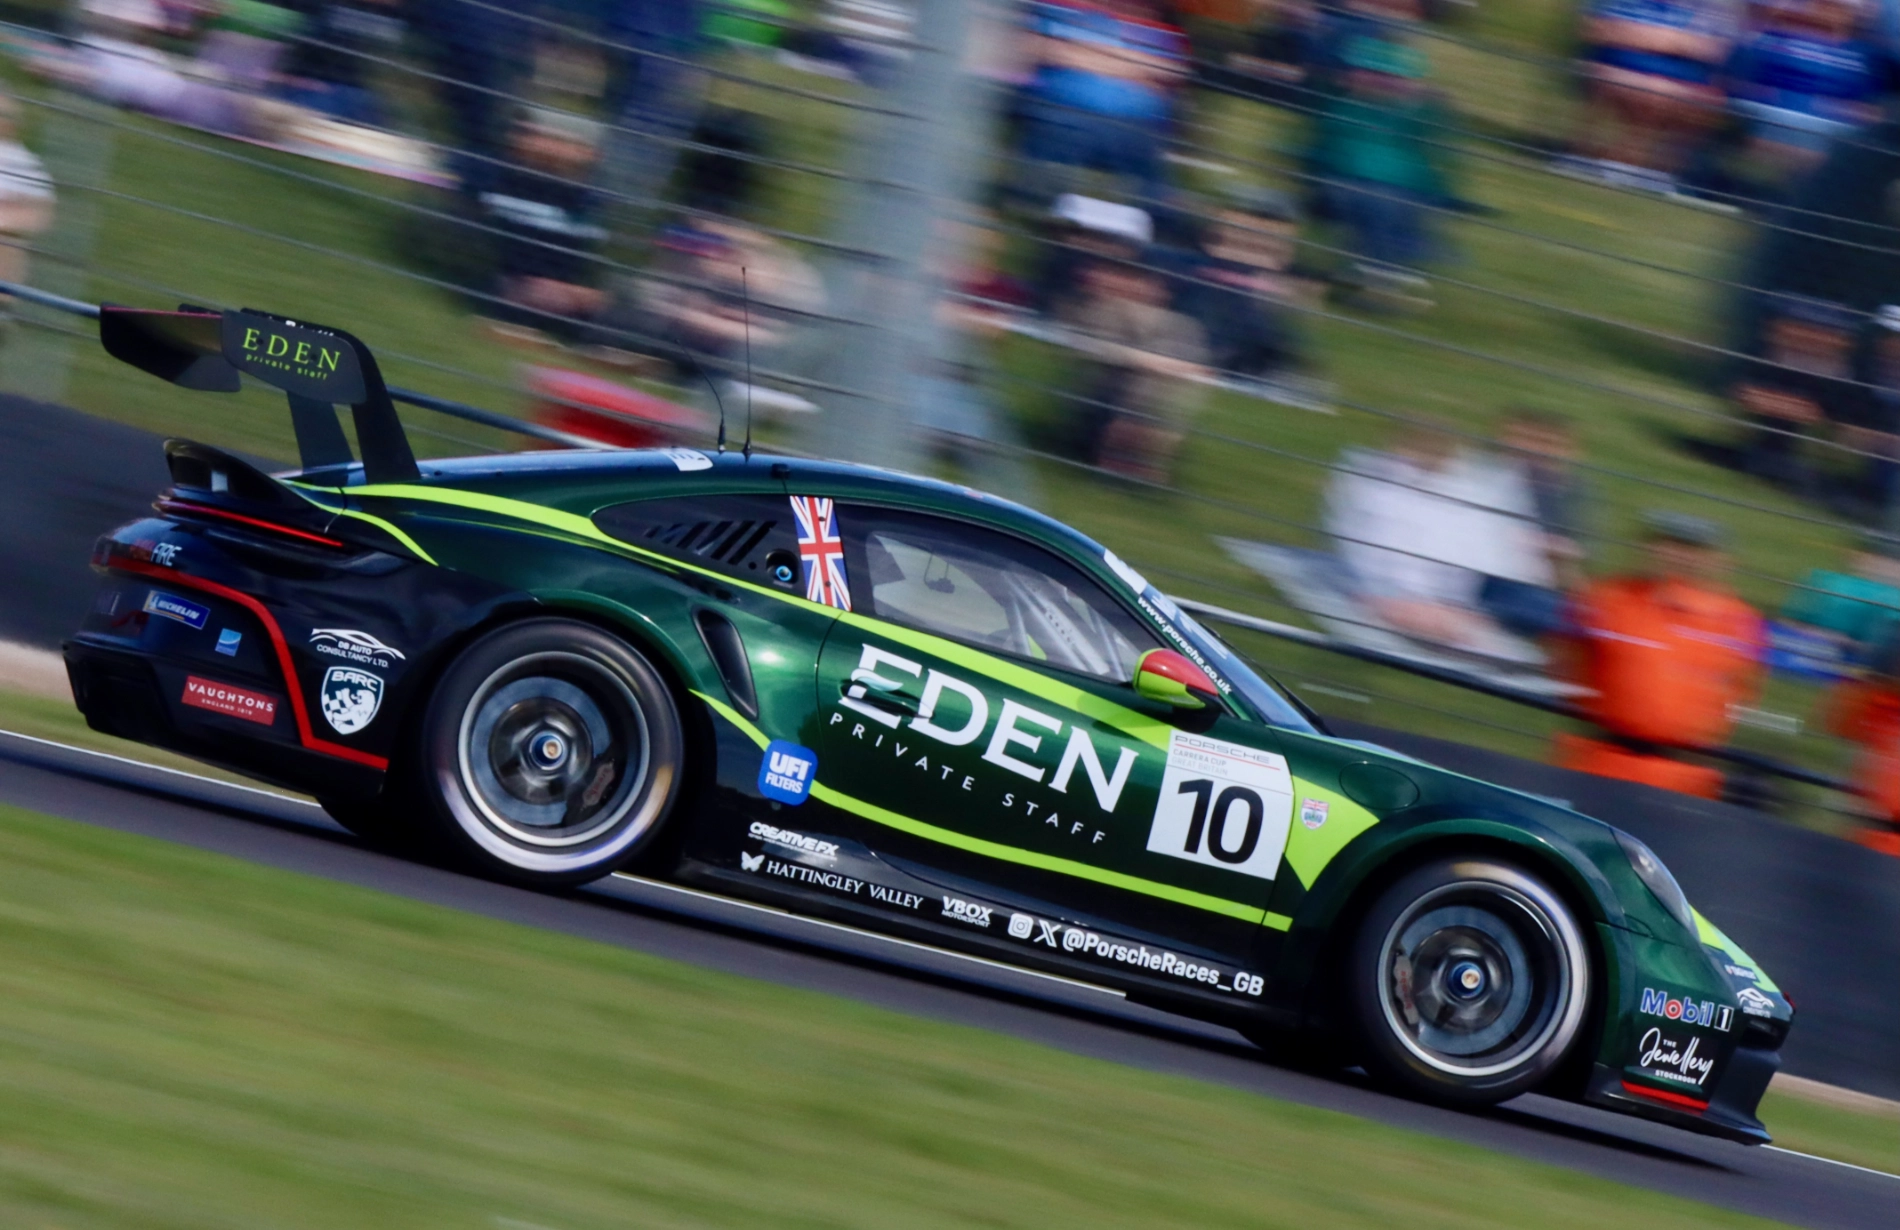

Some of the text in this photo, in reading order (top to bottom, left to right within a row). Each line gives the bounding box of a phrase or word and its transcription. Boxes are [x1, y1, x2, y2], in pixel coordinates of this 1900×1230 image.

[242, 327, 341, 372] EDEN
[246, 354, 327, 380] private staff
[157, 599, 200, 620] MICHELIN
[316, 644, 373, 664] CONSULTANCY
[350, 644, 372, 656] AUTO
[1137, 596, 1233, 695] www.porsche.co.uk
[331, 670, 378, 692] BARC
[188, 682, 274, 712] VAUGHTONS
[201, 698, 235, 711] ENGLAND
[838, 643, 1140, 813] EDEN
[1173, 748, 1227, 767] CARRERA CUP
[1175, 735, 1270, 764] PORSCHE
[769, 751, 810, 781] UFI
[830, 712, 1105, 844] PRIVATE STAFF
[1171, 756, 1228, 776] GREAT BRITAIN
[765, 771, 803, 794] FILTERS
[1177, 778, 1264, 864] 10
[766, 860, 923, 909] HATTINGLEY VALLEY
[941, 909, 991, 928] MOTORSPORT
[942, 895, 993, 922] VBOX
[1062, 928, 1265, 996] @PorscheRaces_GB
[1640, 987, 1714, 1027] Mobil
[1639, 1027, 1714, 1085] Jewellery
[1663, 1039, 1677, 1048] THE
[1655, 1069, 1697, 1085] STOCKROOM
